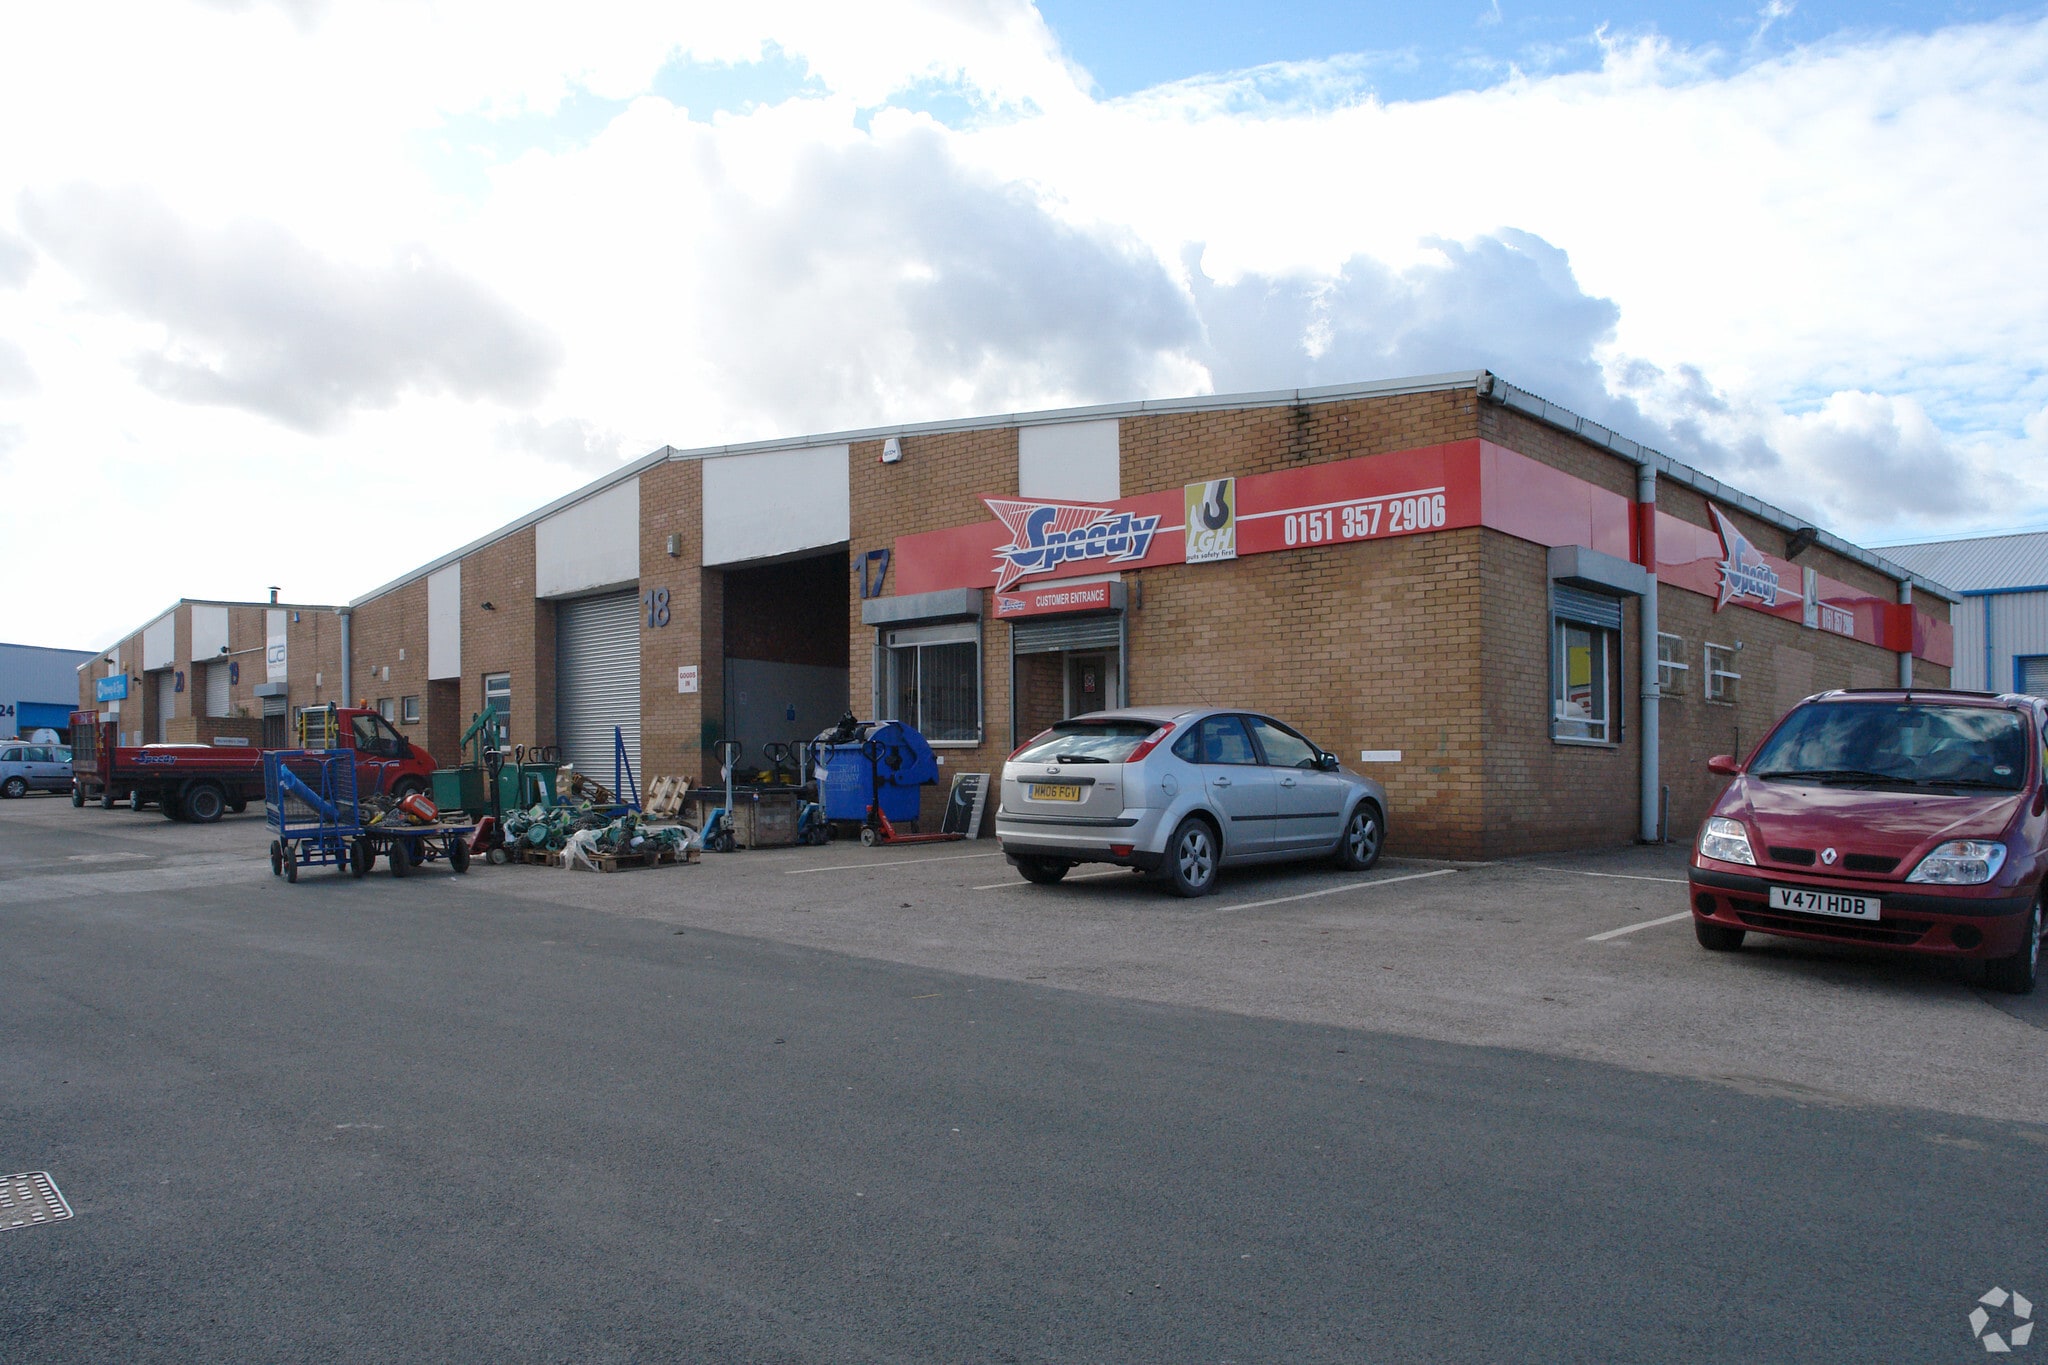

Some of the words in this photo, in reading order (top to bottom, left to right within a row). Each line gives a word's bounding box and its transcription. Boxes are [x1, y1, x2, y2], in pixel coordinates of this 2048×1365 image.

[1284, 510, 1333, 546] 0151
[1341, 503, 1382, 538] 357
[1389, 494, 1446, 532] 2906
[1008, 506, 1158, 569] Speedy
[1186, 526, 1233, 553] LGH
[1186, 554, 1199, 562] puts
[1201, 550, 1220, 559] safety
[1221, 549, 1234, 557] first
[852, 548, 890, 599] 17
[1727, 536, 1779, 605] Speedy
[643, 587, 670, 629] 18
[1035, 592, 1070, 607] CUSTOMER
[1070, 589, 1105, 604] ENTRANCE
[174, 670, 184, 692] 20
[229, 661, 239, 685] 19
[680, 671, 696, 679] GOODS
[131, 750, 178, 765] Speedy
[1781, 890, 1822, 910] V471
[1827, 895, 1866, 915] HDB
